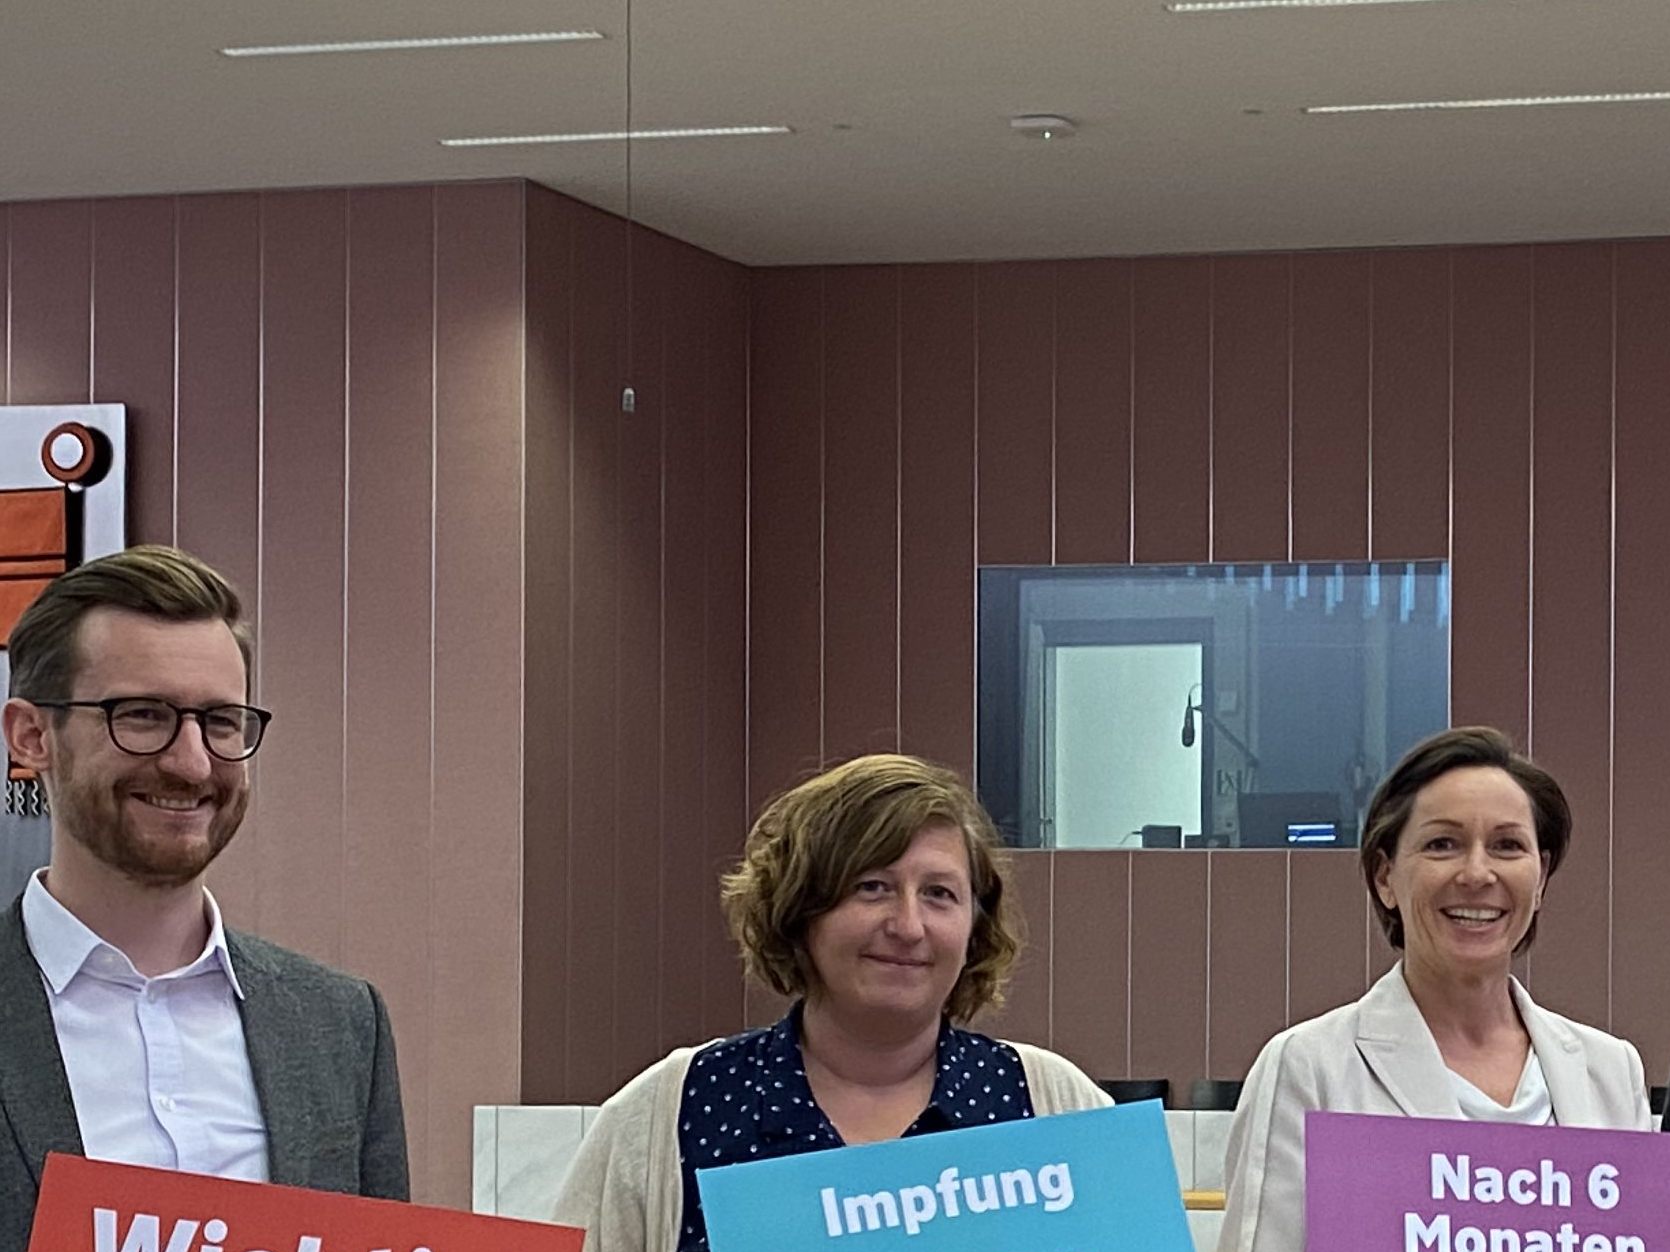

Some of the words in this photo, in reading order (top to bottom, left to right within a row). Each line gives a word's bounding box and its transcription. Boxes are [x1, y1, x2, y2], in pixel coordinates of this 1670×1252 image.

[819, 1162, 1075, 1237] Impfung
[1430, 1153, 1572, 1207] Nach
[1587, 1162, 1621, 1210] 6
